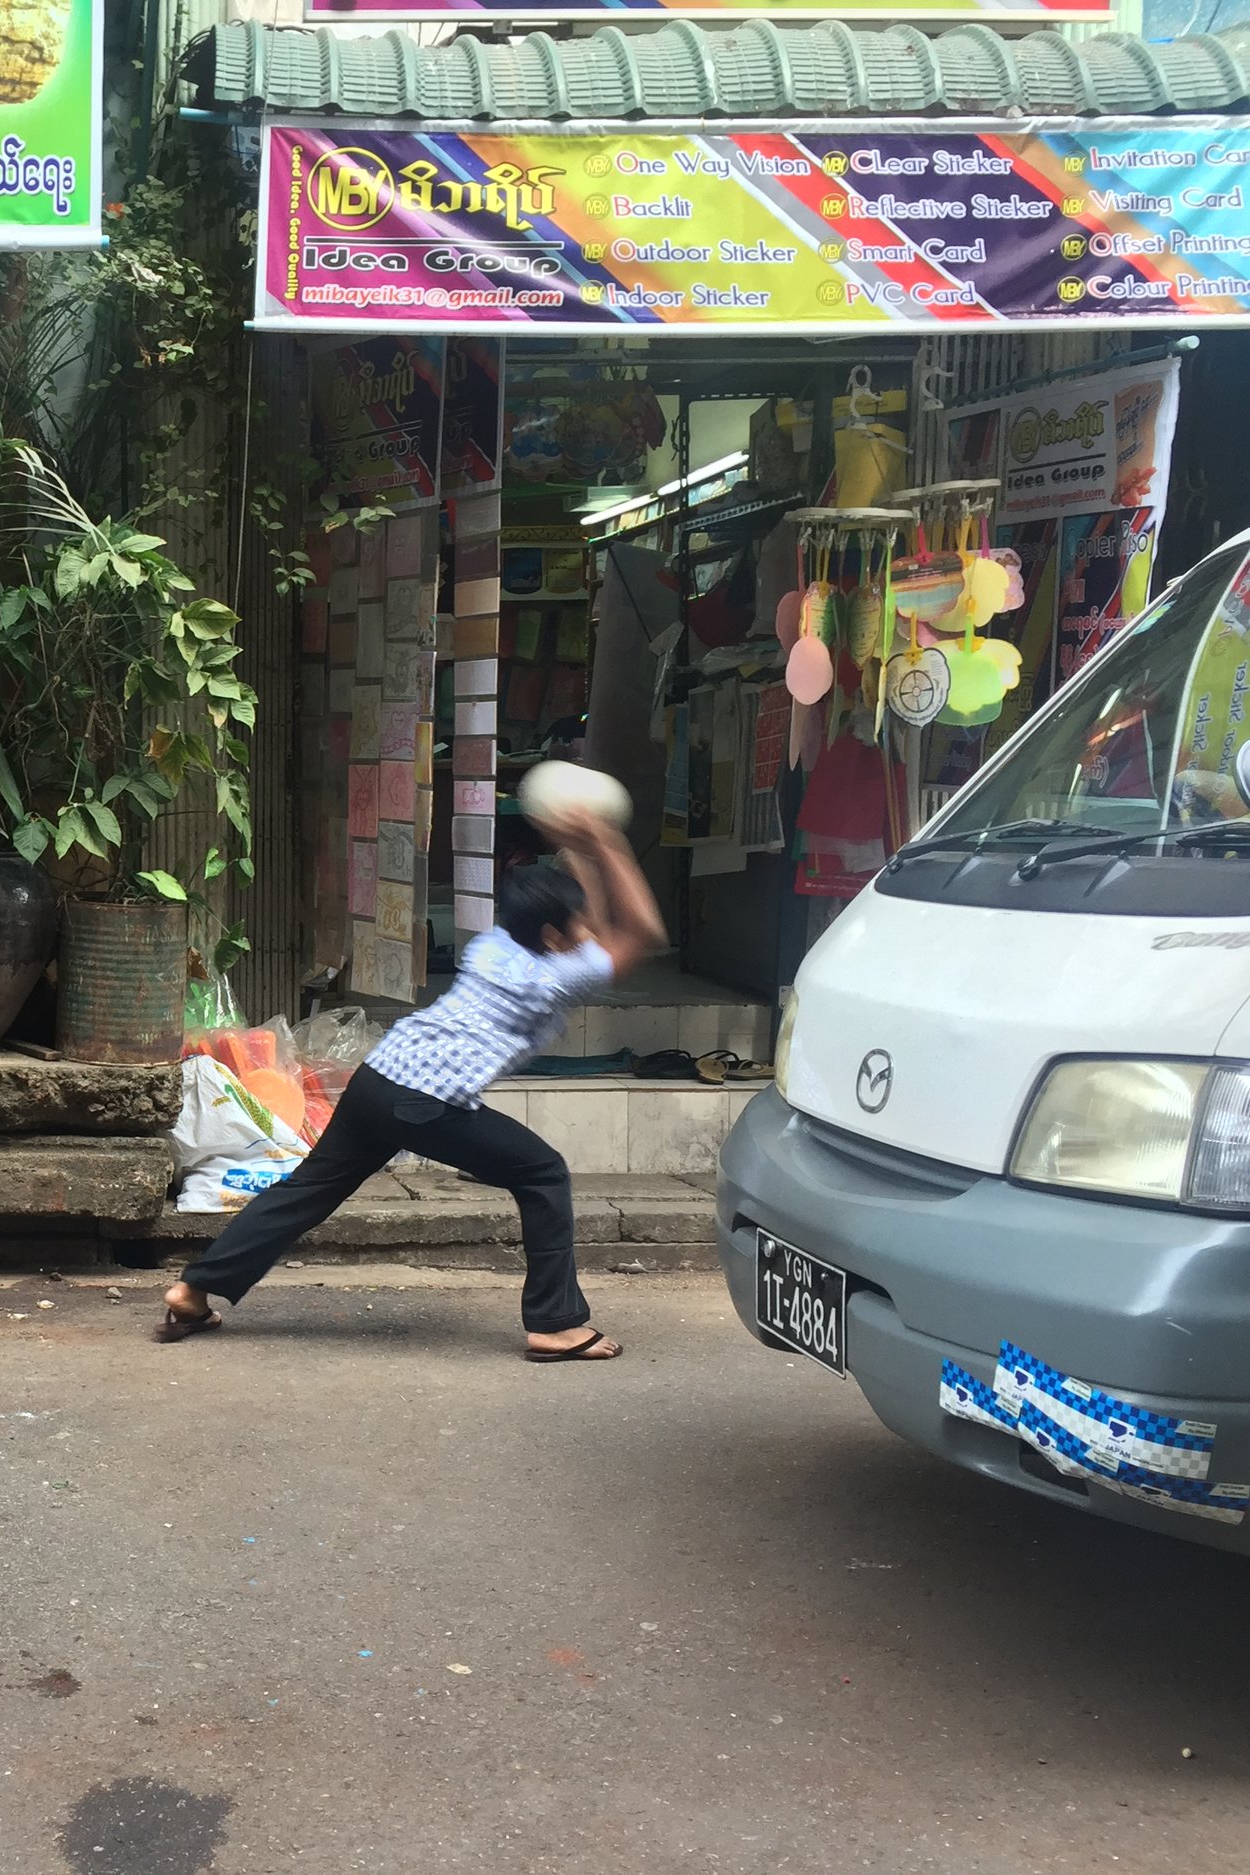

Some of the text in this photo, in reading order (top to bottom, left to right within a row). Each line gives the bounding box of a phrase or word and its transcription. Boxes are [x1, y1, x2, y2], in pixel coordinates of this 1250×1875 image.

[291, 145, 303, 178] Good
[616, 152, 667, 174] One
[674, 151, 731, 178] Way
[737, 151, 810, 175] Vision
[934, 150, 1012, 174] Sticker
[1090, 147, 1196, 169] Invitation
[1204, 144, 1250, 164] Car
[317, 166, 387, 216] MBY
[1089, 190, 1172, 216] Visiting
[1182, 187, 1242, 208] Card
[612, 196, 692, 217] Backlit
[850, 195, 966, 218] Reflective
[972, 195, 1052, 217] Sticker
[289, 217, 301, 250] Good
[1089, 232, 1164, 257] Offset
[304, 247, 561, 278] Idea Group
[613, 239, 711, 262] Outdoor
[719, 239, 795, 262] Sticker
[847, 239, 915, 262] Smart
[922, 239, 985, 262] Card
[284, 252, 300, 300] Quality
[1087, 275, 1171, 299] Colour
[303, 285, 562, 308] mibayeik31@gmail.com
[608, 284, 684, 306] Indoor
[692, 284, 769, 306] Sticker
[846, 283, 905, 305] PVC
[911, 283, 975, 305] Card
[368, 435, 422, 461] Group
[1007, 463, 1105, 491] Idea Group
[783, 1249, 813, 1289] YGN
